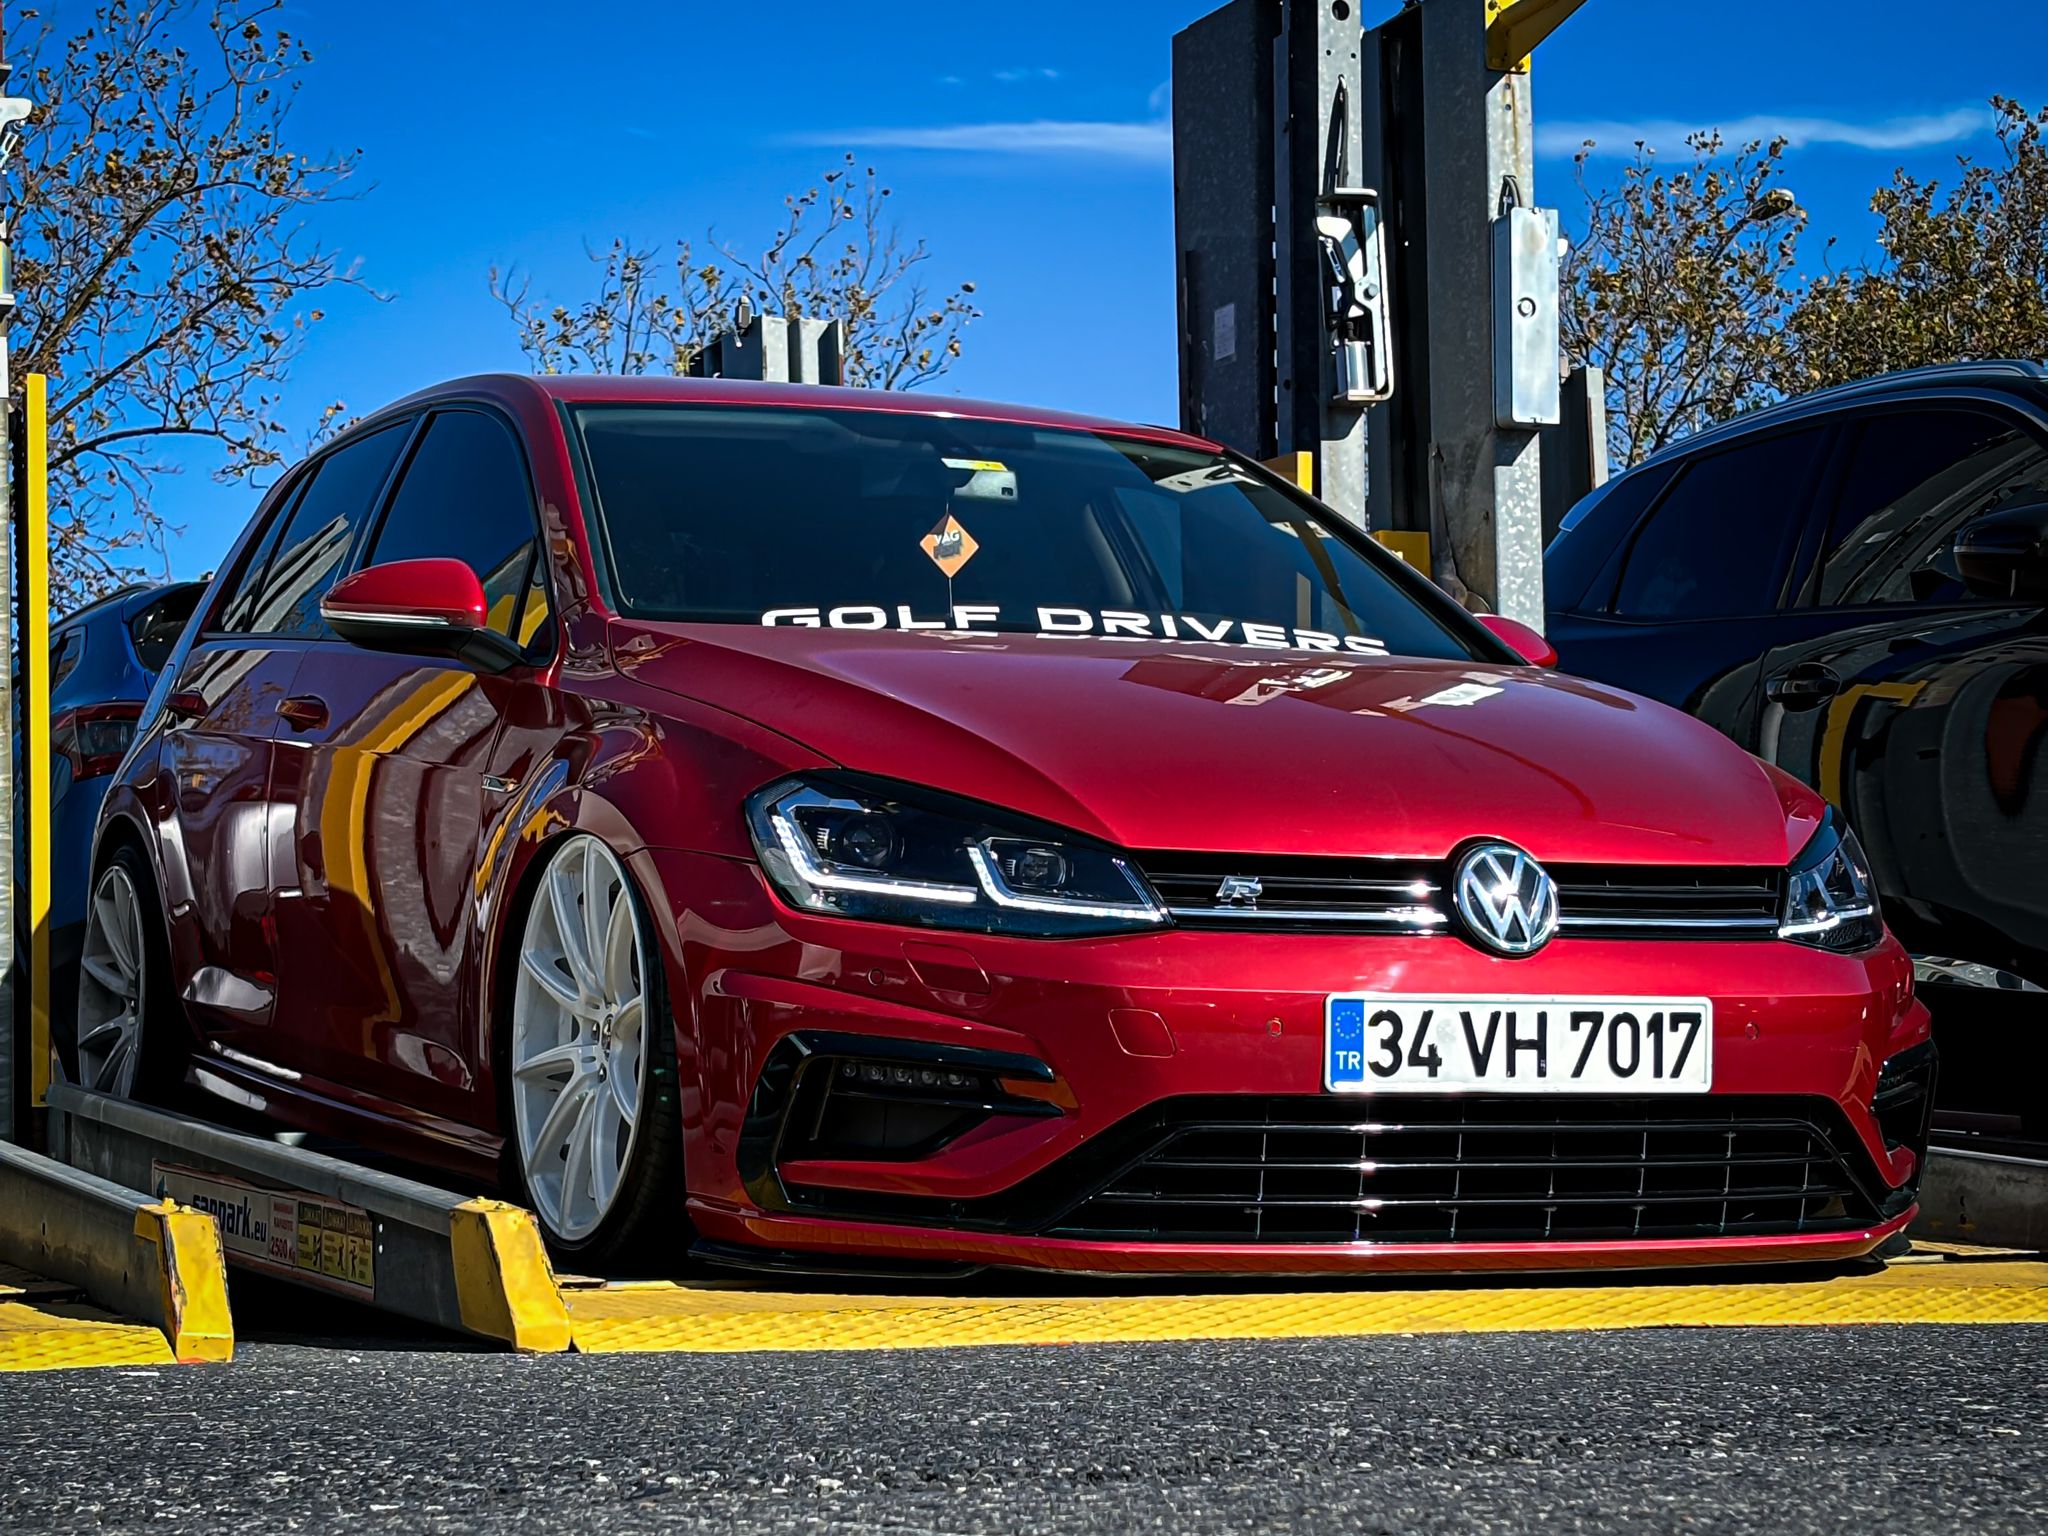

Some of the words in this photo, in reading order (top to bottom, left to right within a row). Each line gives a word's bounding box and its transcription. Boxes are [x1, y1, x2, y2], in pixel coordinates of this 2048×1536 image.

[935, 530, 961, 545] VAG
[761, 604, 1001, 631] GOLF
[1035, 607, 1391, 657] DRIVERS
[1215, 875, 1264, 912] R
[1335, 1050, 1361, 1070] TR
[1367, 1009, 1443, 1078] 34
[1458, 1010, 1549, 1079] VH
[1569, 1010, 1703, 1080] 7017
